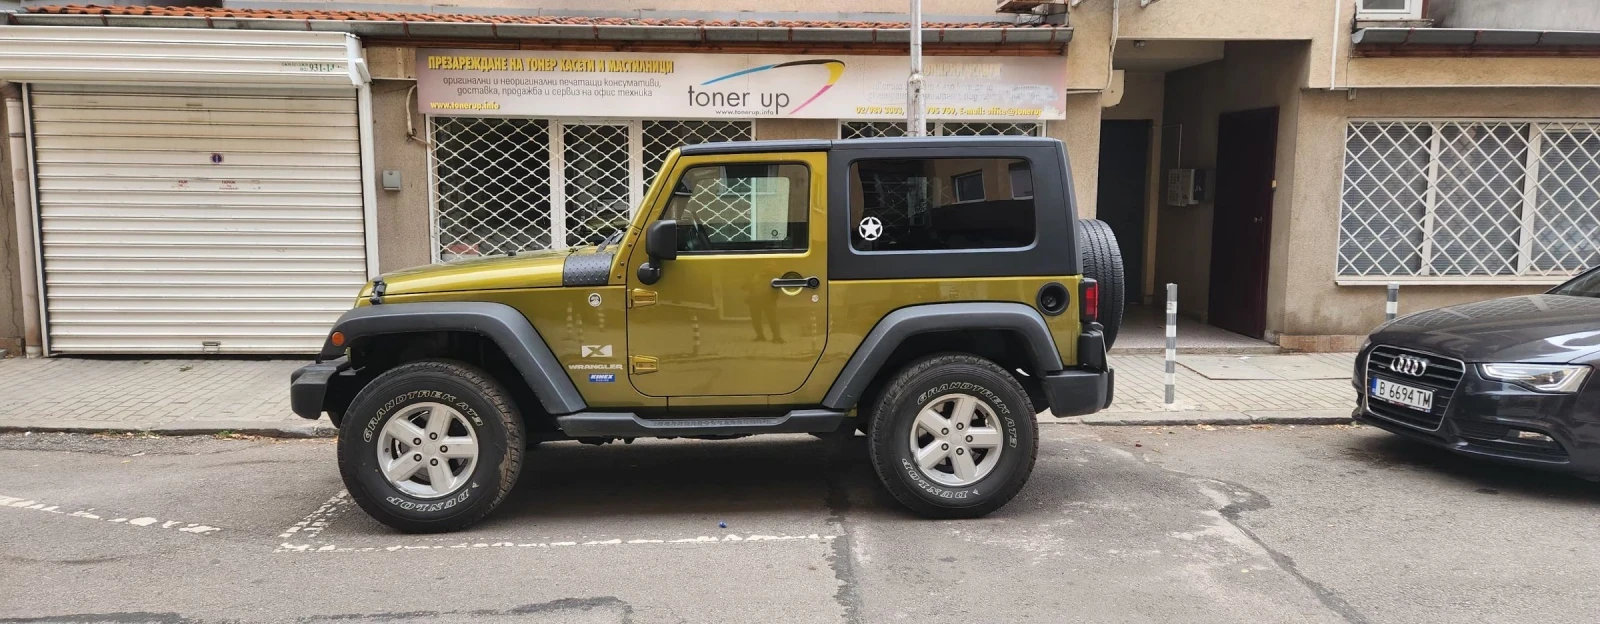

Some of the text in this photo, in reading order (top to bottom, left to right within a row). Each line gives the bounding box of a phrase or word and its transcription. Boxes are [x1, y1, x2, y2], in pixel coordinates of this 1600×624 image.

[428, 56, 674, 75] ПРЕЗАРЕЖДАНЕ НА ТОНЕР КАСЕТИ И МАСТИЛНИЦИ
[443, 77, 491, 86] оригинални
[500, 79, 559, 87] неоригинални
[560, 79, 602, 88] печатащи
[604, 77, 661, 88] консумативи,
[457, 86, 500, 96] доставка,
[502, 87, 542, 97] продажба
[552, 87, 580, 97] сервиз
[594, 87, 615, 97] офис
[618, 87, 652, 97] техника
[430, 101, 500, 110] www.tonerup.info
[688, 85, 790, 115] toner up
[917, 381, 1010, 415] GRANDTREK
[1380, 381, 1386, 395] B
[1389, 385, 1414, 403] 6694
[1416, 391, 1431, 407] TM
[363, 389, 457, 443] GRANDTREK
[902, 458, 969, 499] DUNLOP
[386, 488, 470, 512] DUNLOP
